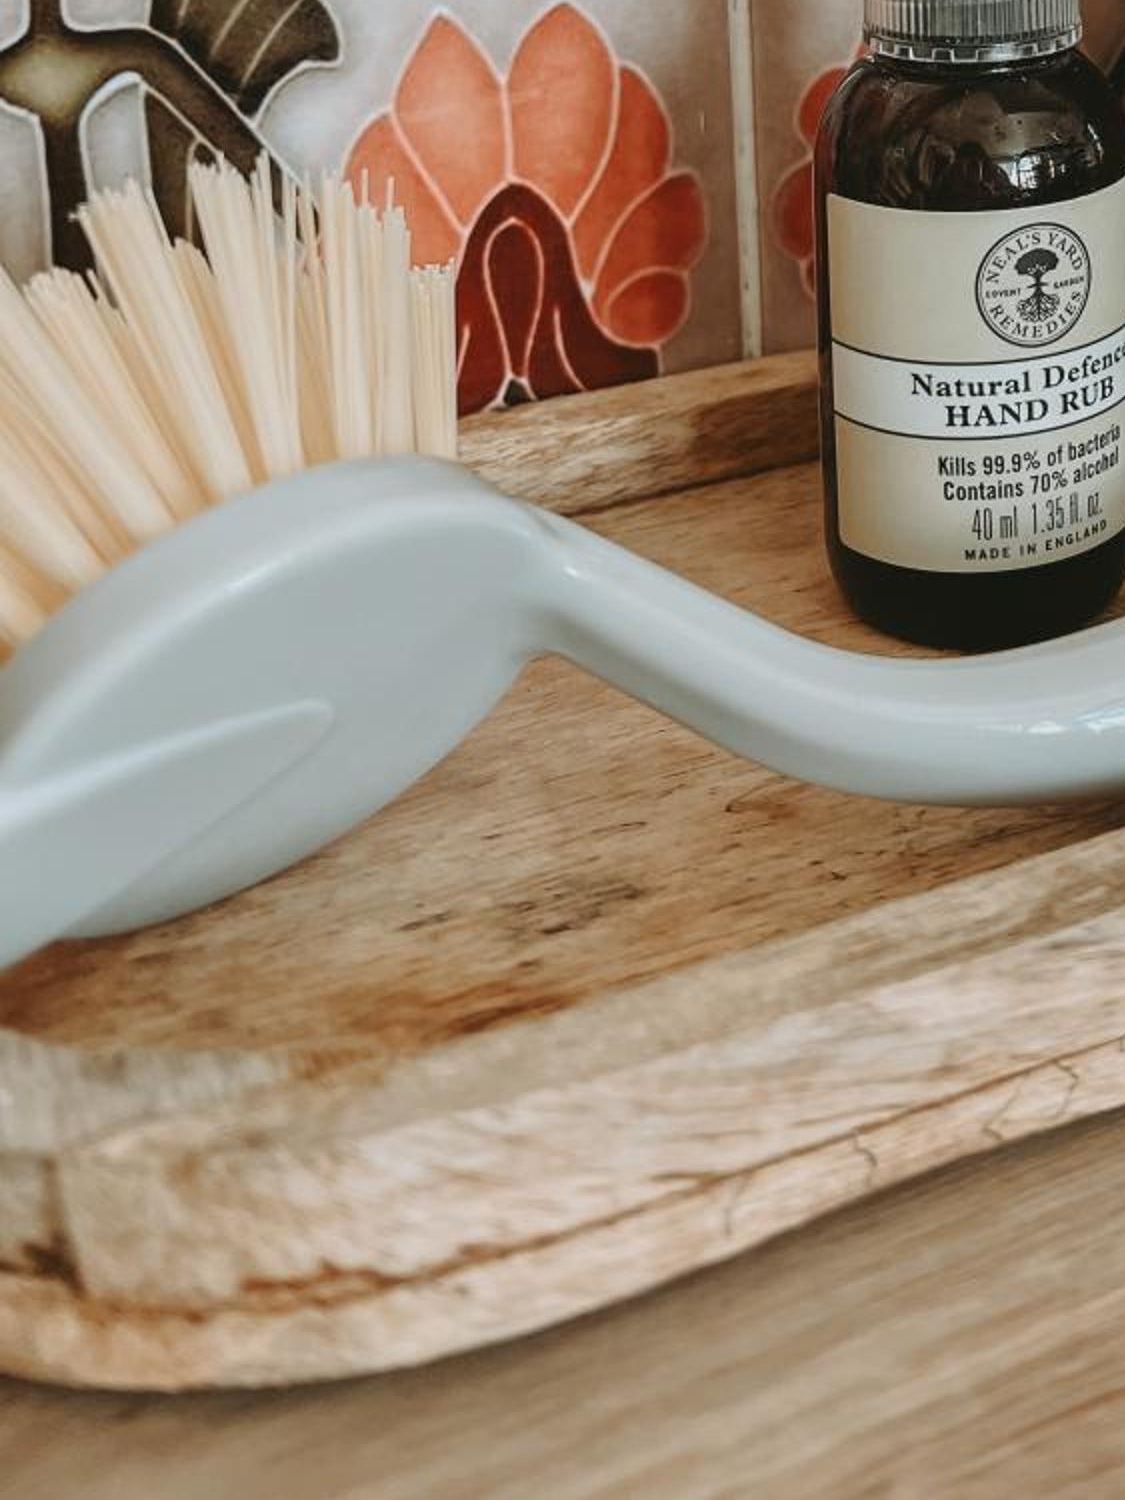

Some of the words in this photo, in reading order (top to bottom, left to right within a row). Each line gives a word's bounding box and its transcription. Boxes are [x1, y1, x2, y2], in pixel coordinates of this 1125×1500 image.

[985, 231, 1041, 284] NEAL'S
[1048, 232, 1083, 271] YARD
[990, 291, 1081, 338] REMEDIES
[910, 369, 1032, 398] Natural
[944, 398, 1050, 427] HAND
[1060, 375, 1115, 415] RUB
[938, 455, 977, 477] Kills
[983, 450, 1041, 476] 99.9%
[1047, 444, 1064, 467] of
[1068, 423, 1121, 461] bacteria
[943, 480, 1024, 501] Contains
[1030, 468, 1069, 495] 70%
[1073, 445, 1120, 485] alcohol
[964, 547, 1011, 561] MADE
[1020, 543, 1037, 555] IN
[1045, 519, 1108, 551] ENGLAND
[971, 507, 993, 542] 40
[1000, 504, 1018, 539] ml
[1031, 497, 1065, 536] 1.35
[1087, 492, 1103, 519] oz.
